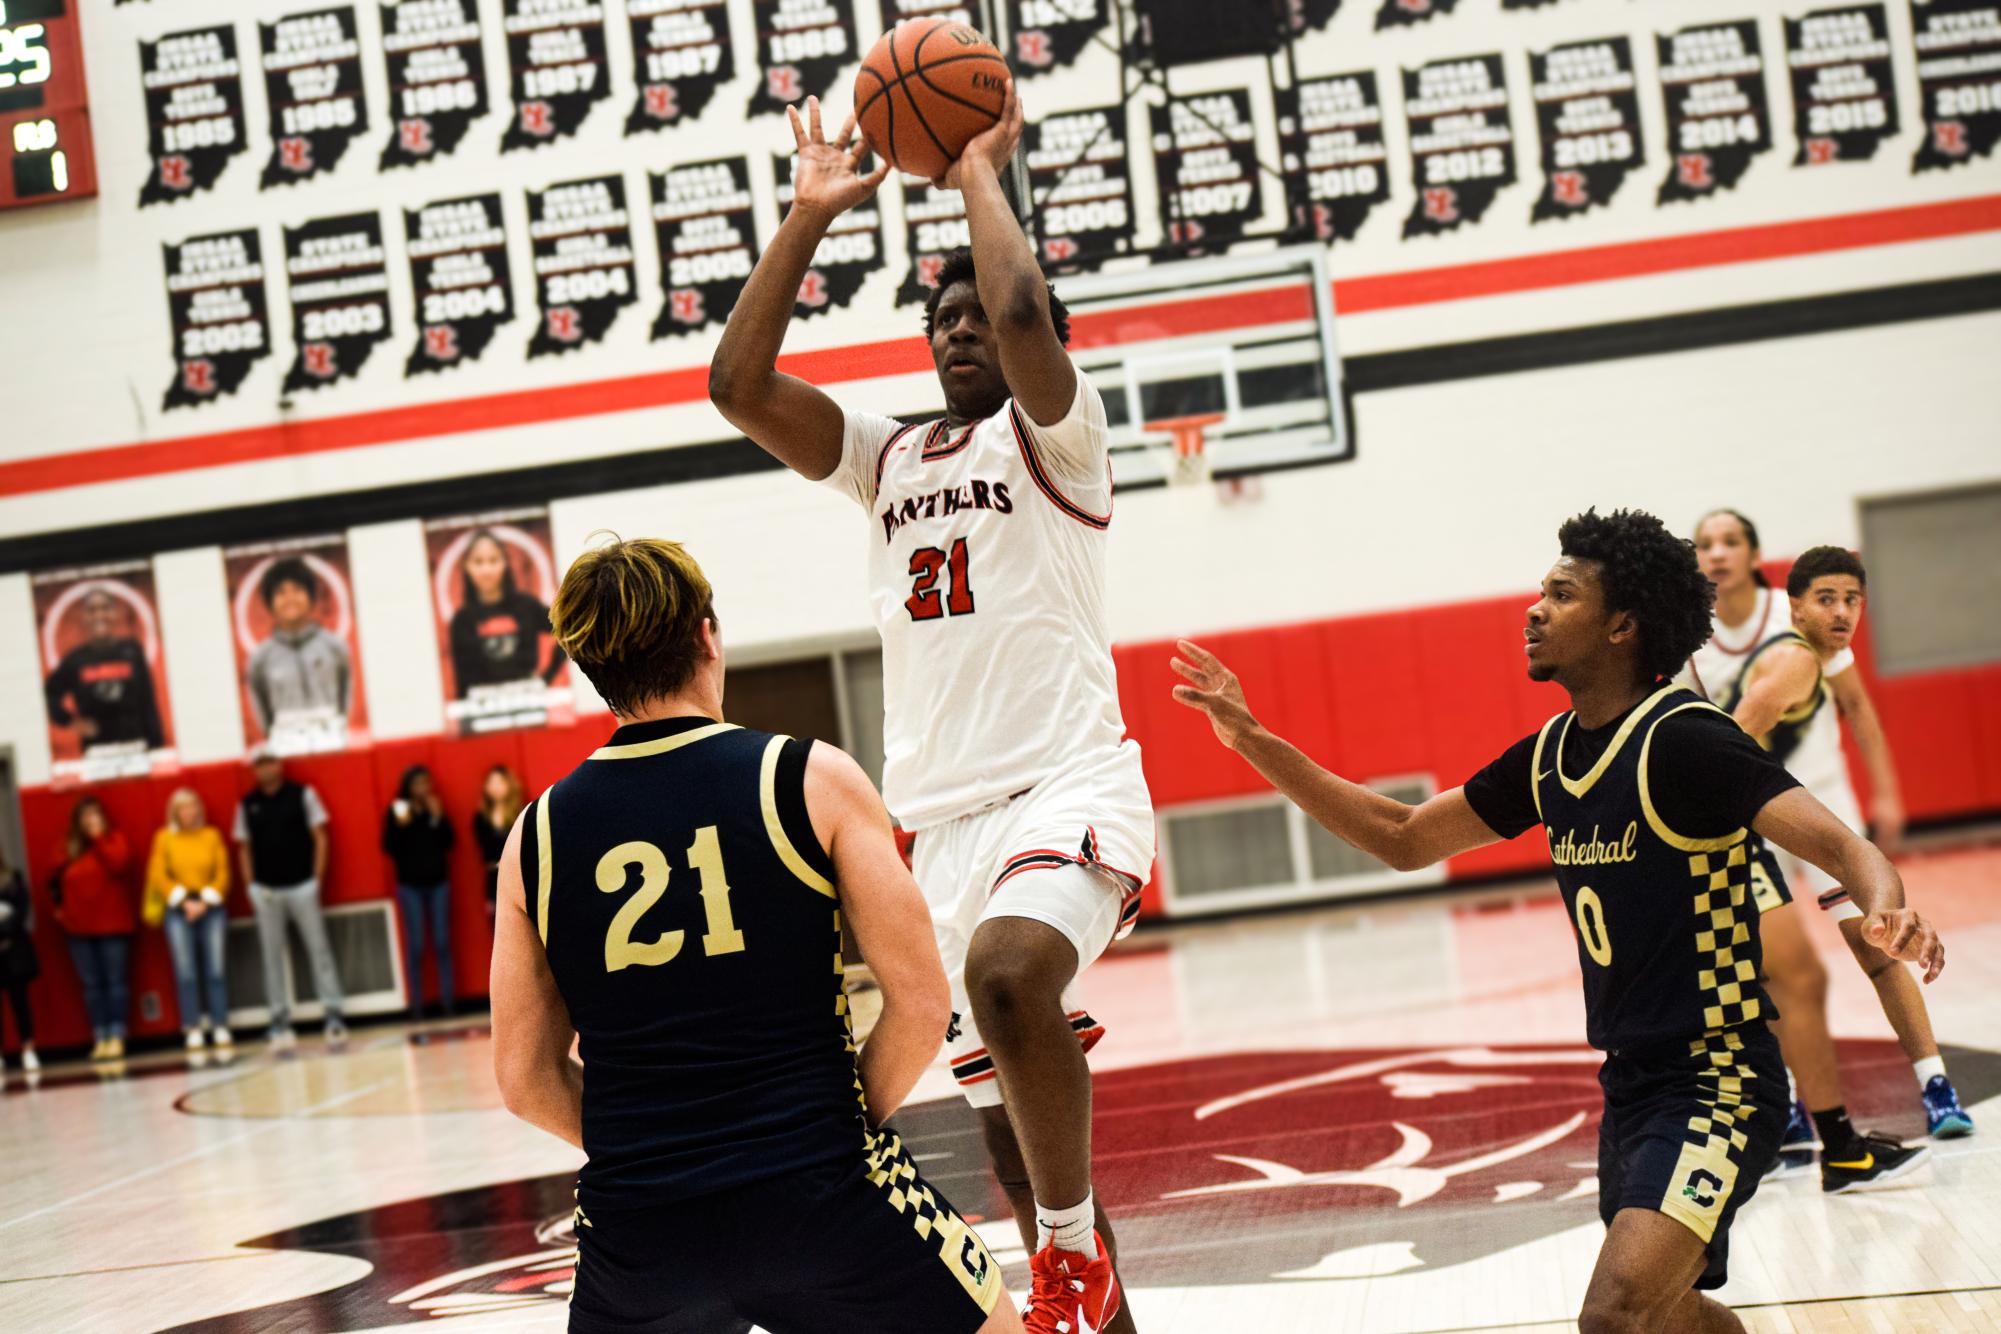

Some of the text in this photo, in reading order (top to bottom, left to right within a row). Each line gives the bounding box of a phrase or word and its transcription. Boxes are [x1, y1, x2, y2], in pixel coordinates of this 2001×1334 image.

[648, 47, 720, 80] 1987
[525, 65, 596, 98] 1987
[285, 102, 353, 132] 1985
[1680, 116, 1756, 149] 2014
[1809, 100, 1883, 132] 2015
[165, 120, 232, 150] 1985
[1554, 135, 1630, 167] 2013
[51, 150, 68, 191] 1
[1426, 151, 1501, 183] 2012
[670, 251, 749, 285] 2005
[547, 270, 627, 303] 2004
[425, 288, 503, 321] 2004
[303, 306, 382, 339] 2003
[183, 324, 261, 356] 2002
[881, 479, 1013, 545] PANTHERS
[904, 536, 975, 622] 21
[1546, 820, 1637, 866] Cathedral
[595, 825, 746, 973] 21
[1575, 886, 1612, 967] 0
